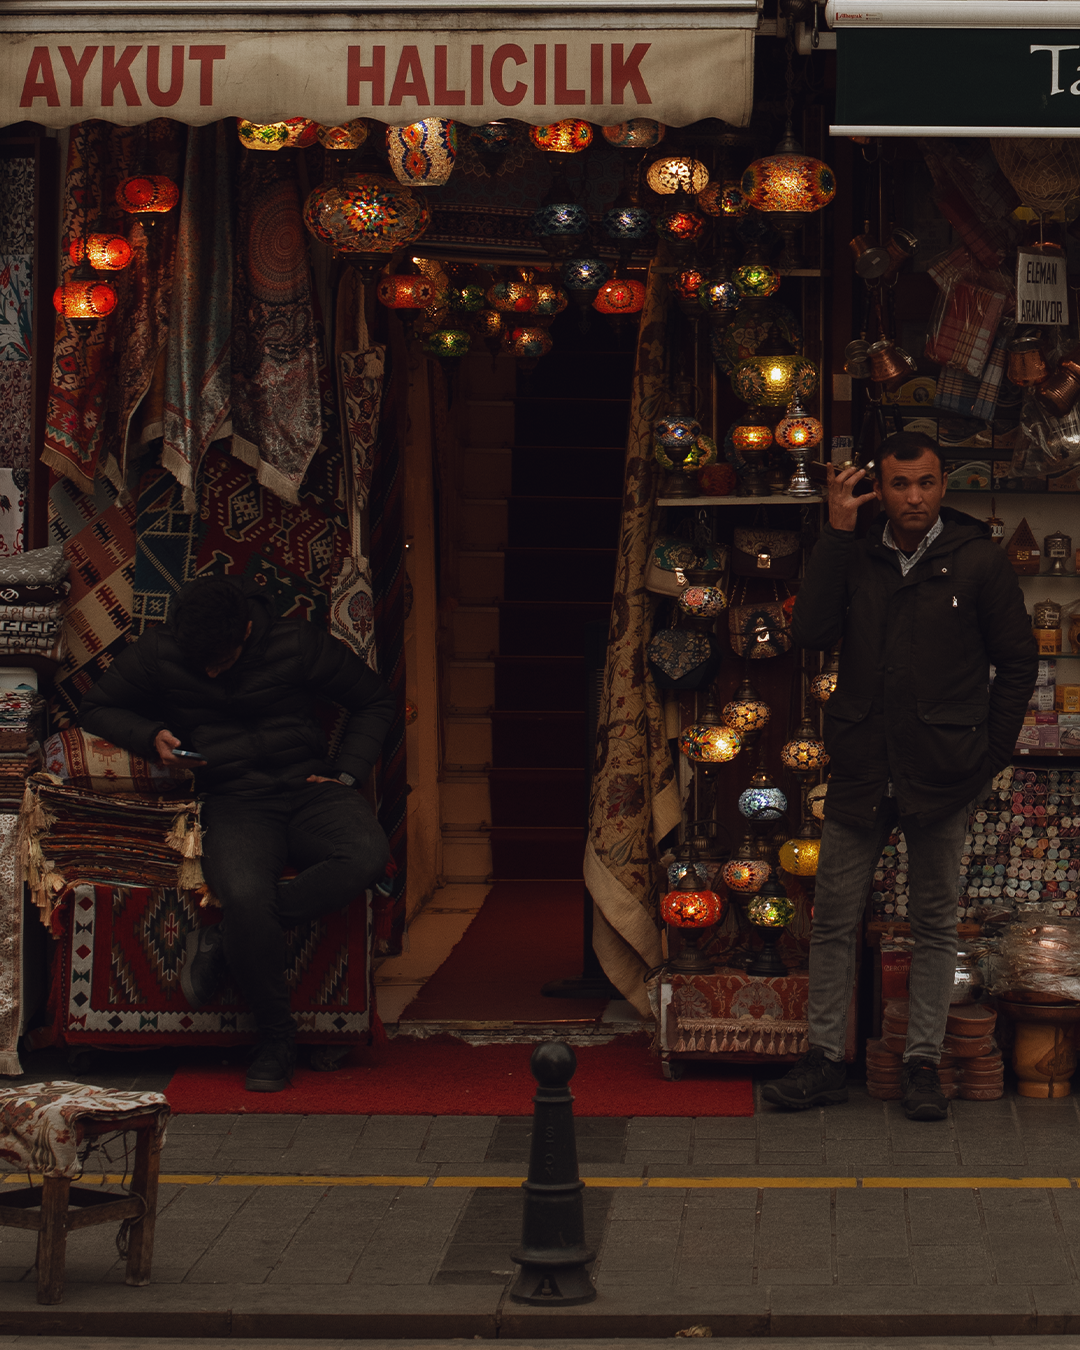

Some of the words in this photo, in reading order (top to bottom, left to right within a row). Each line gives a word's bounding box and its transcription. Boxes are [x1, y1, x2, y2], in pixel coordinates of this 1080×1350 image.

[19, 44, 226, 109] AYKUT
[346, 42, 653, 108] HALICILIK
[1026, 261, 1058, 285] ELEMAN
[1020, 300, 1063, 324] ARANIYOR
